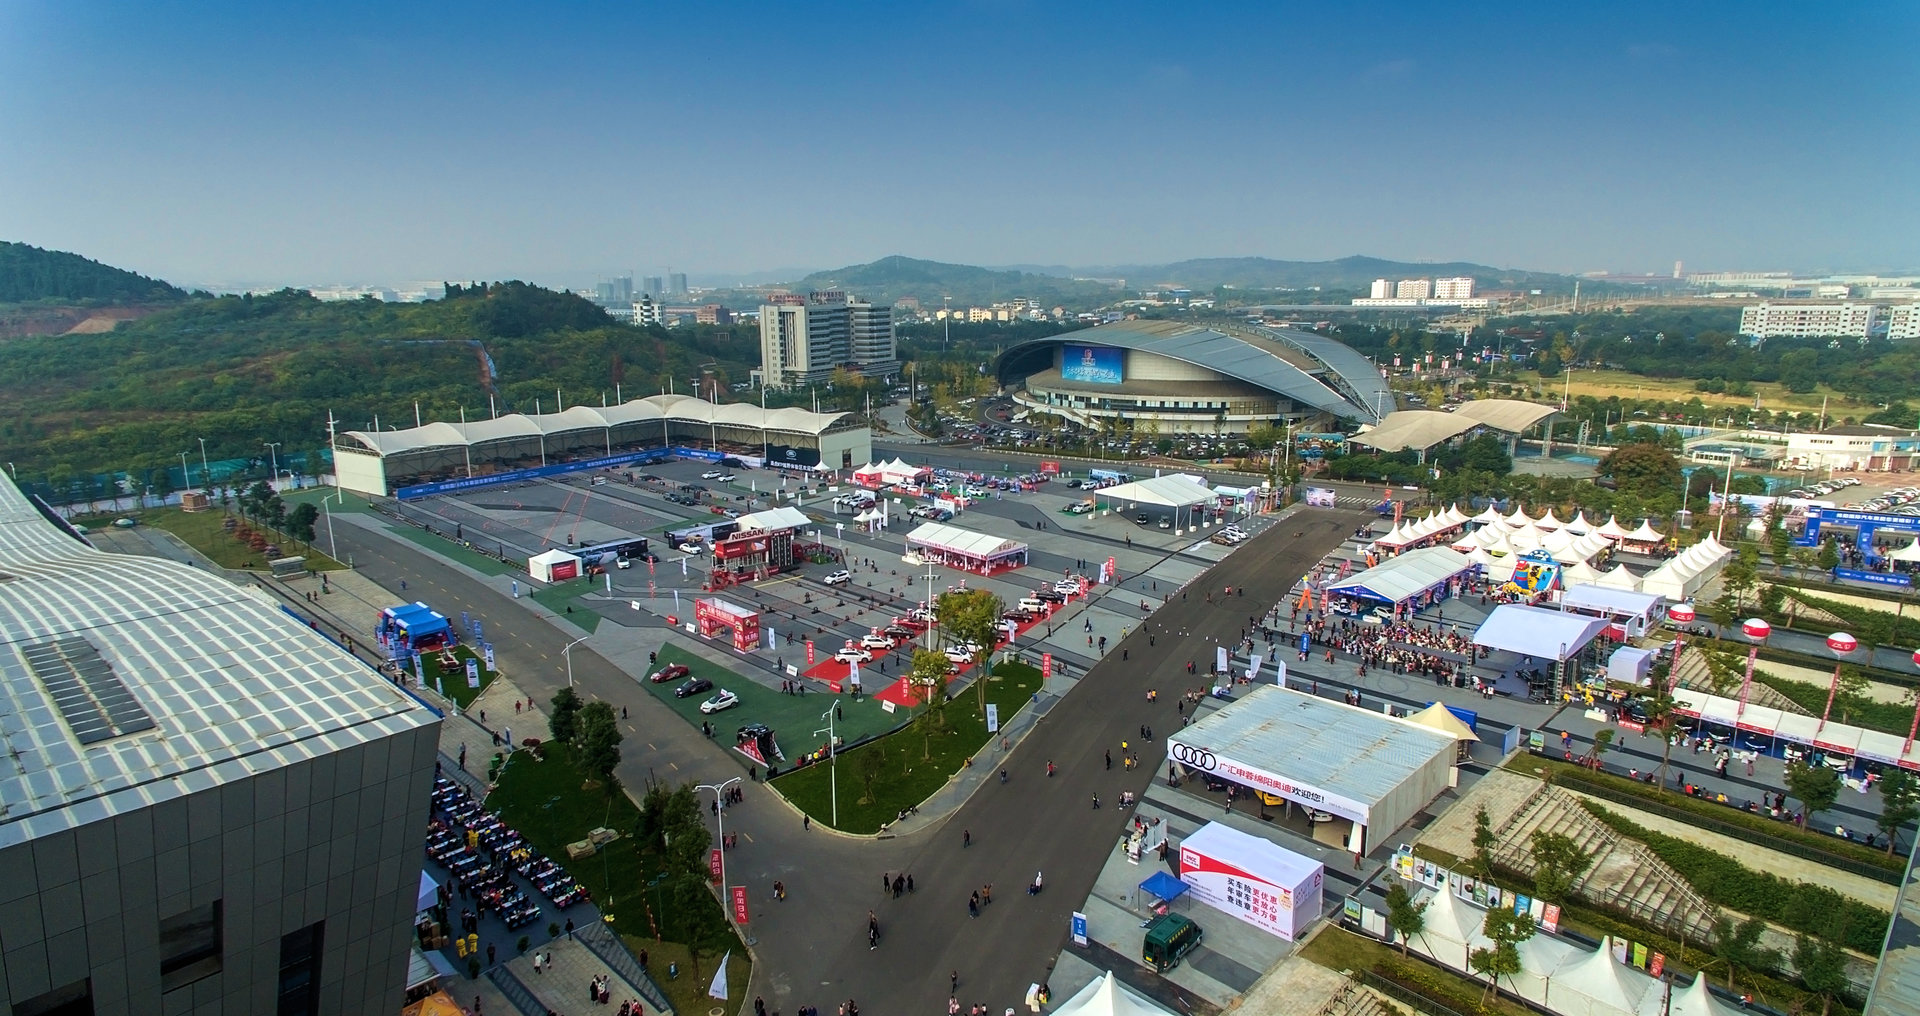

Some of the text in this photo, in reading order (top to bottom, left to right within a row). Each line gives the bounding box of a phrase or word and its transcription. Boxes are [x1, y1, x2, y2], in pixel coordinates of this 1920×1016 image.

[731, 528, 764, 541] NISSAN
[1219, 763, 1325, 804] 广汇申蓉绵阳奥迪欢迎您!
[1227, 877, 1278, 905] 买车险更优惠
[1227, 886, 1278, 914] 年审车更放心
[1227, 895, 1278, 923] 查违章更方便
